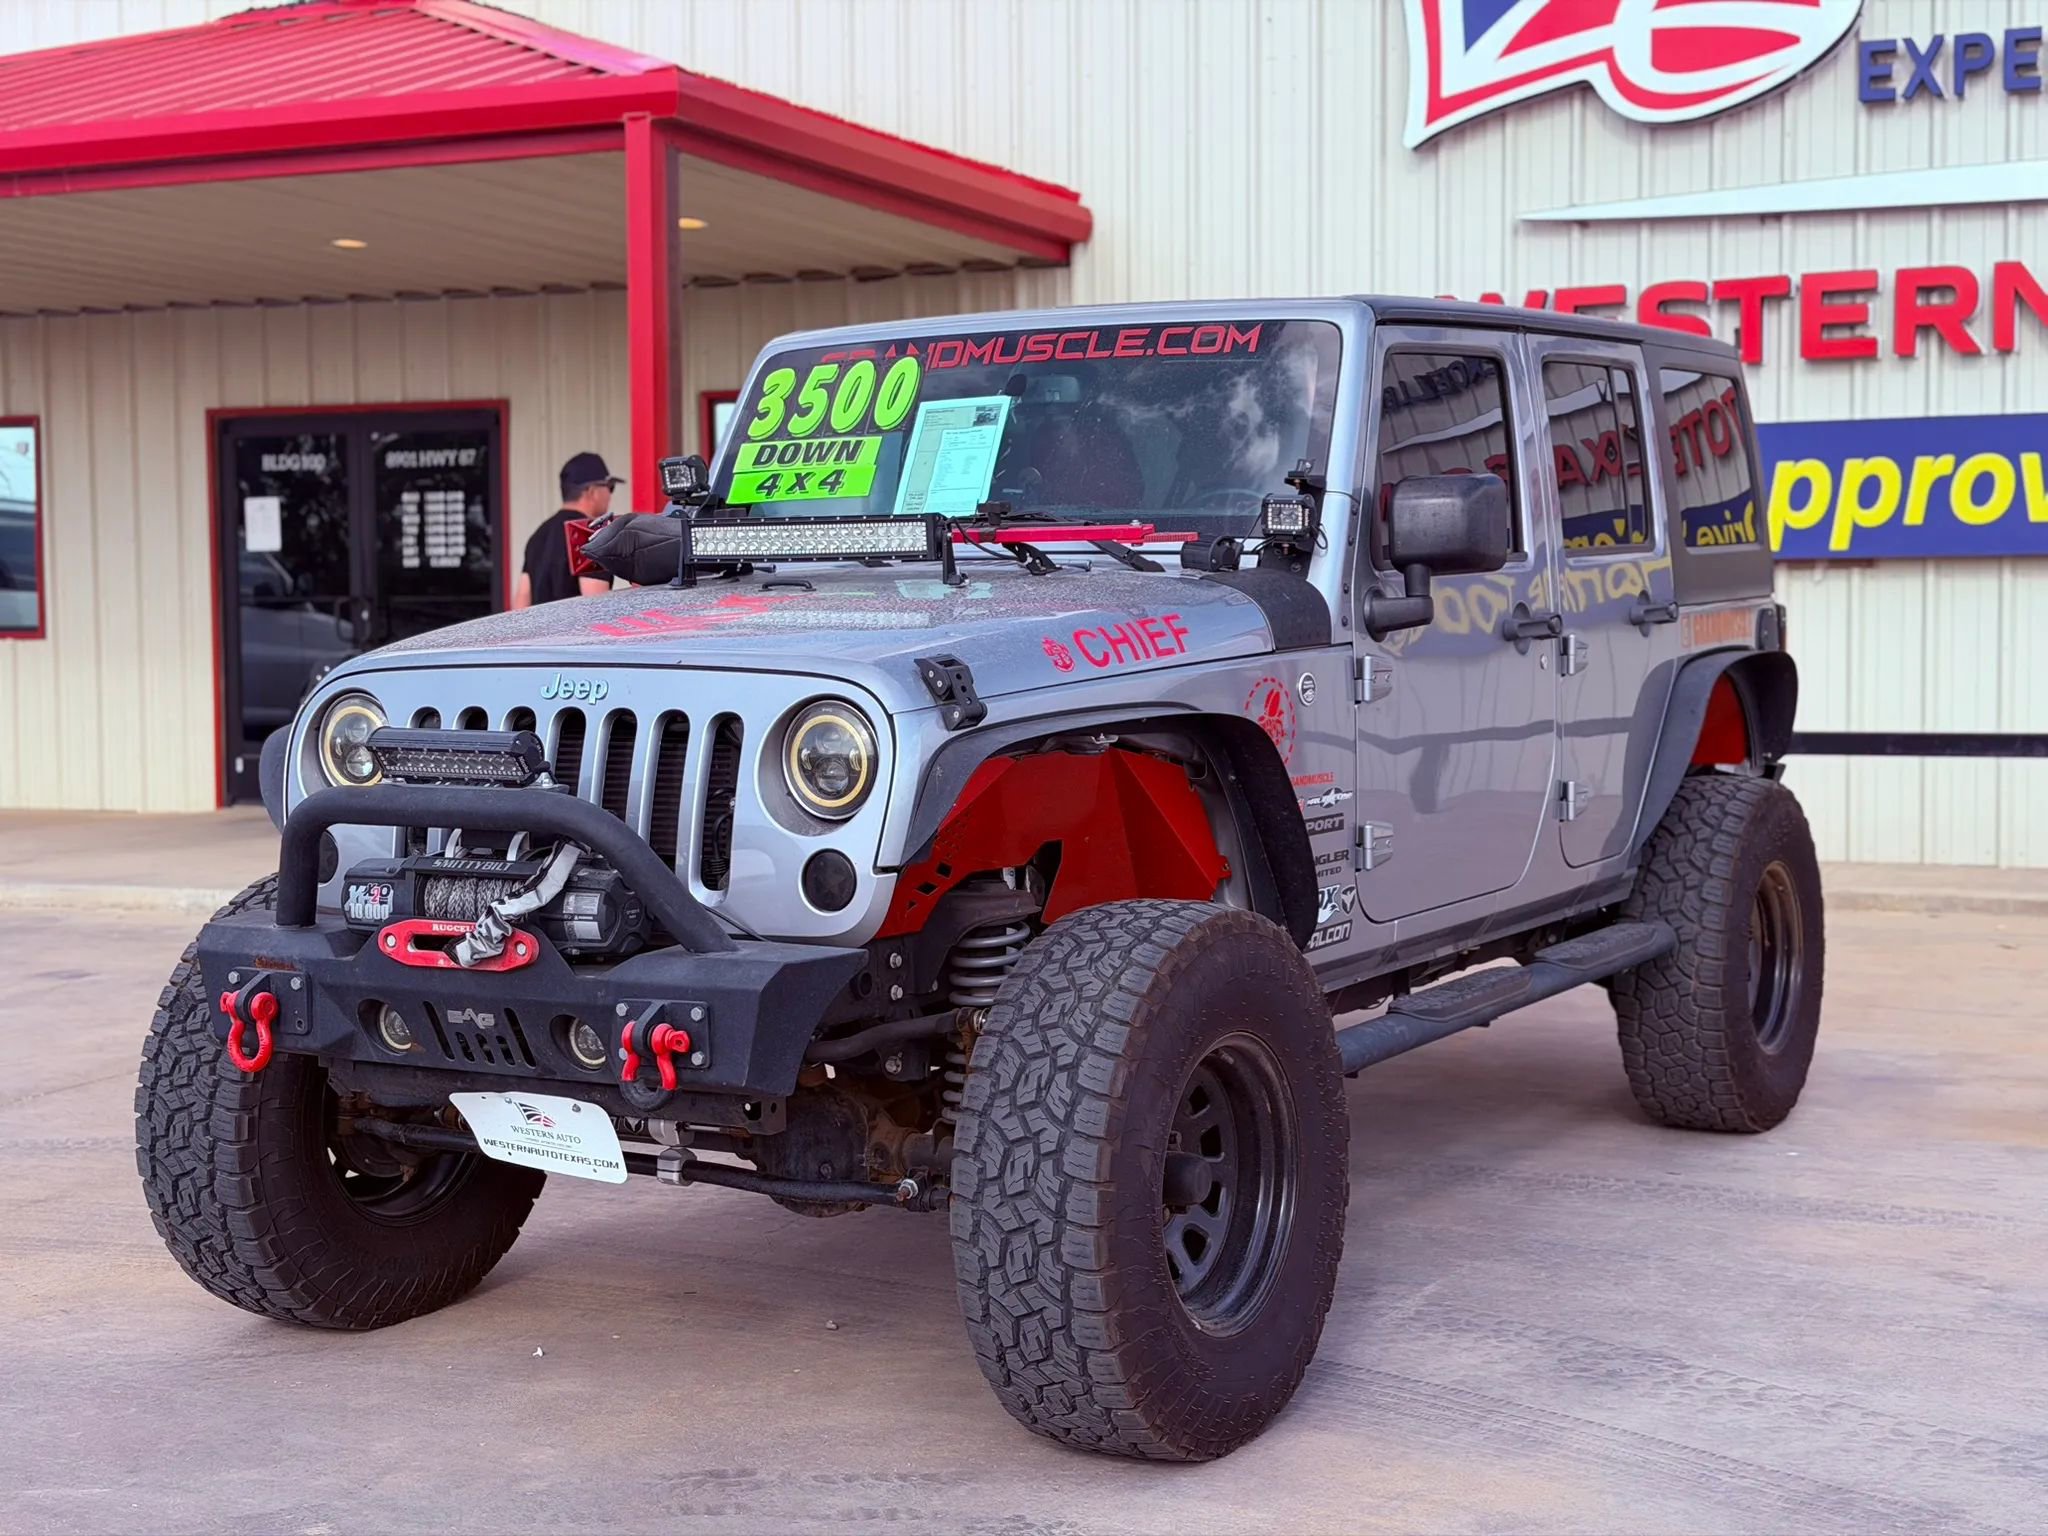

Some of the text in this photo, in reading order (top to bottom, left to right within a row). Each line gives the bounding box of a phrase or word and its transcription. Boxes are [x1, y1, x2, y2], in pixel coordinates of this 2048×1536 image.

[1436, 261, 2048, 365] STERN
[748, 356, 921, 440] 3500
[752, 439, 865, 468] DOWN
[1072, 613, 1190, 668] CHIEF
[541, 673, 609, 705] Jeep
[432, 859, 513, 871] SMITTYBILT
[511, 1125, 554, 1140] WESTERN
[556, 1134, 582, 1144] AUTO
[484, 1137, 620, 1170] WESTERNAUTOTEXAS.COM
